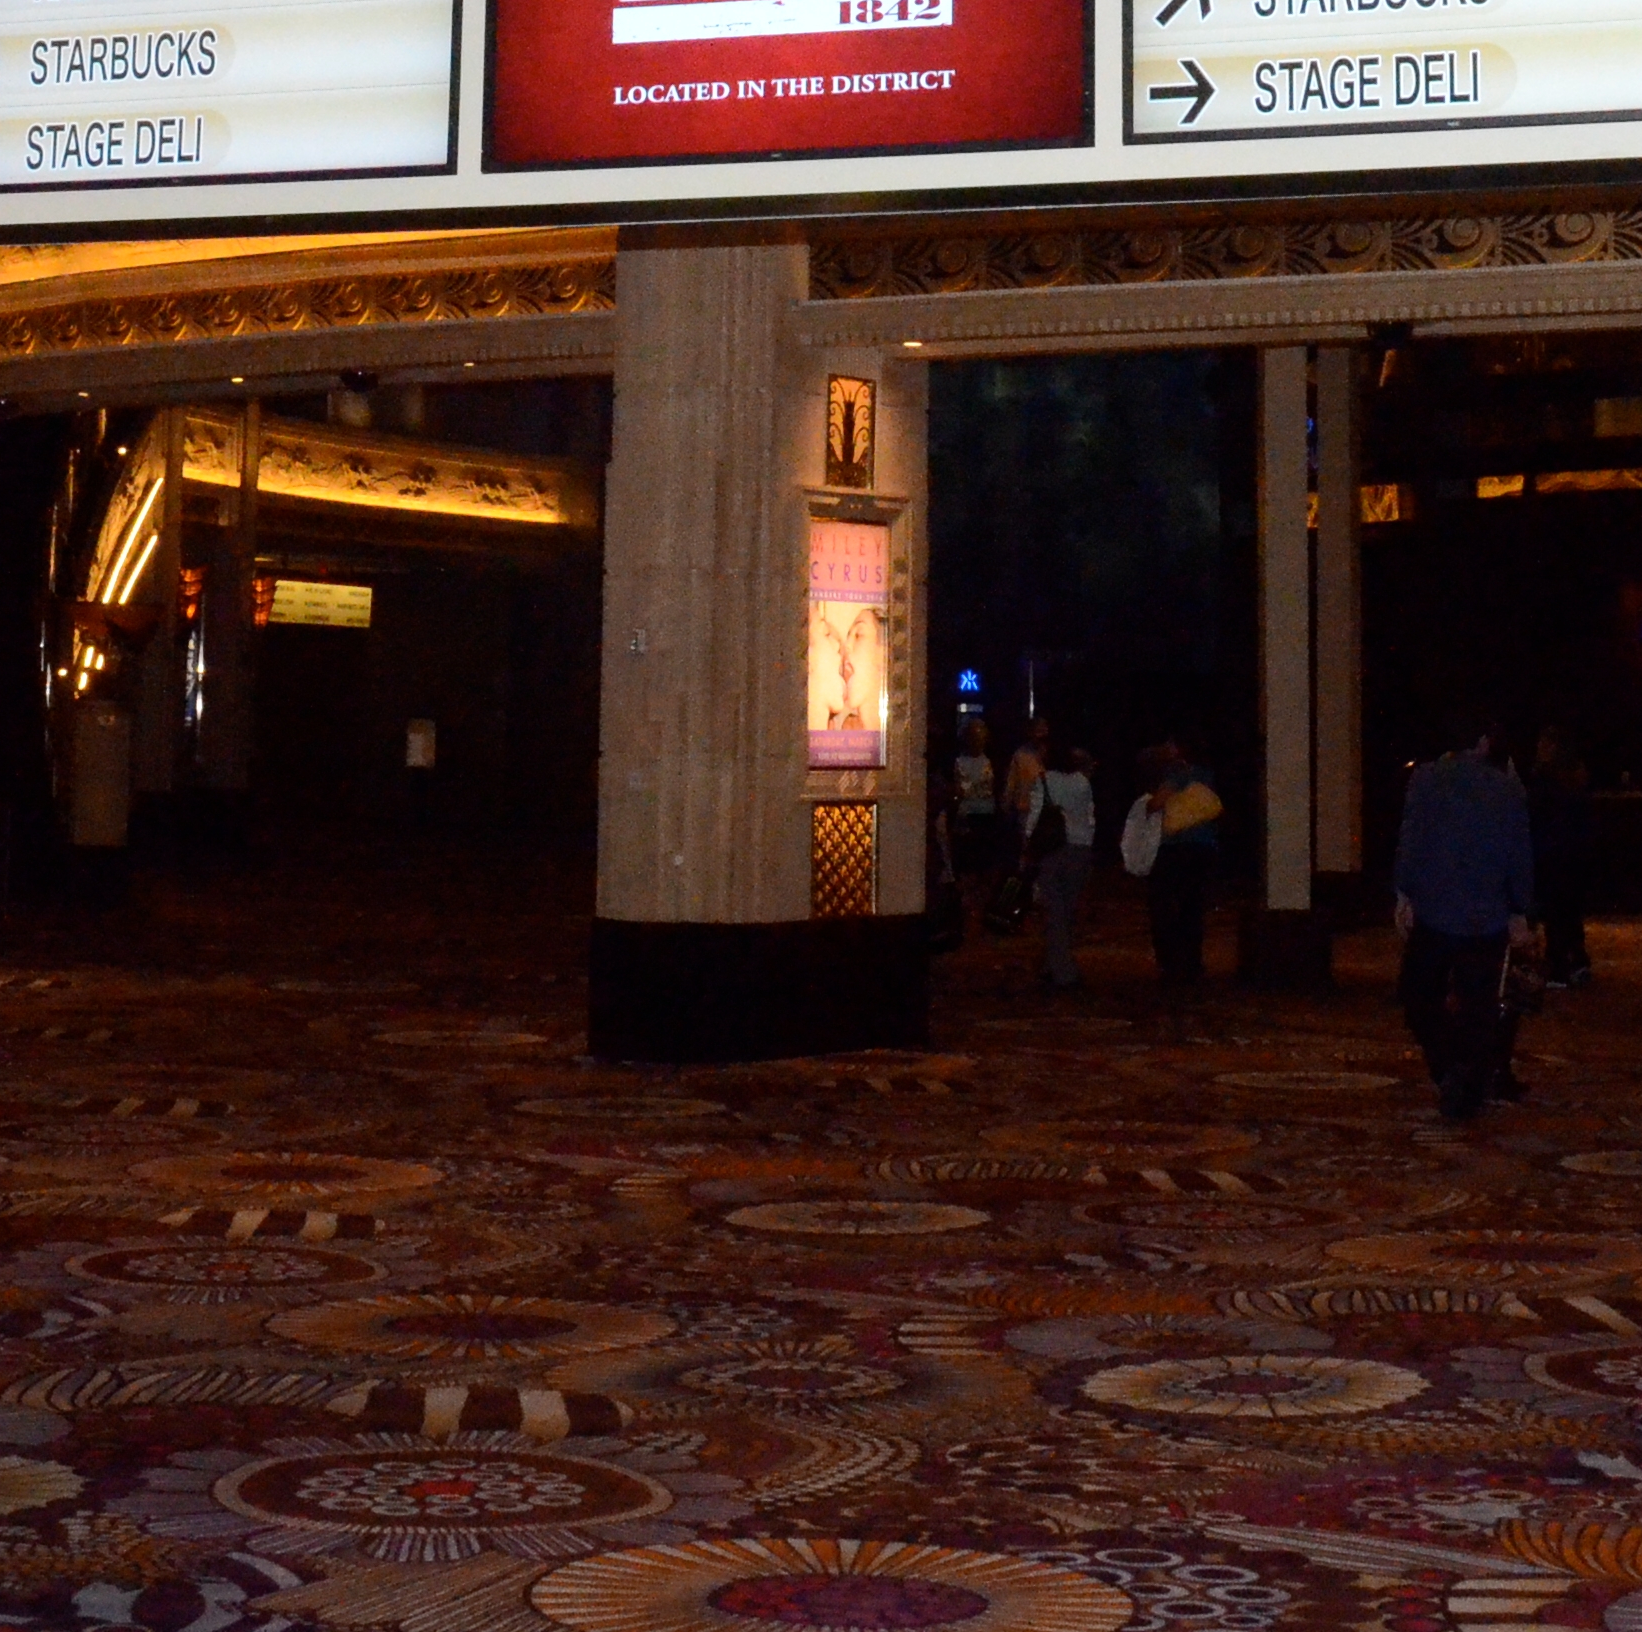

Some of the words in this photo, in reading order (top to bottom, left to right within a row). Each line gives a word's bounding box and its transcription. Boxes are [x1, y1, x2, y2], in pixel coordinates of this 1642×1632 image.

[31, 30, 216, 85] STARBUCKS
[613, 81, 731, 106] LOCATED
[737, 79, 767, 99] IN
[770, 76, 825, 98] THE
[831, 69, 956, 95] DISTRICT
[1255, 58, 1381, 113] STAGE
[1395, 53, 1479, 105] DELI
[26, 122, 125, 170] STAGE
[135, 118, 202, 164] DELI
[812, 532, 882, 557] MILEY
[811, 561, 882, 584] CYRUS
